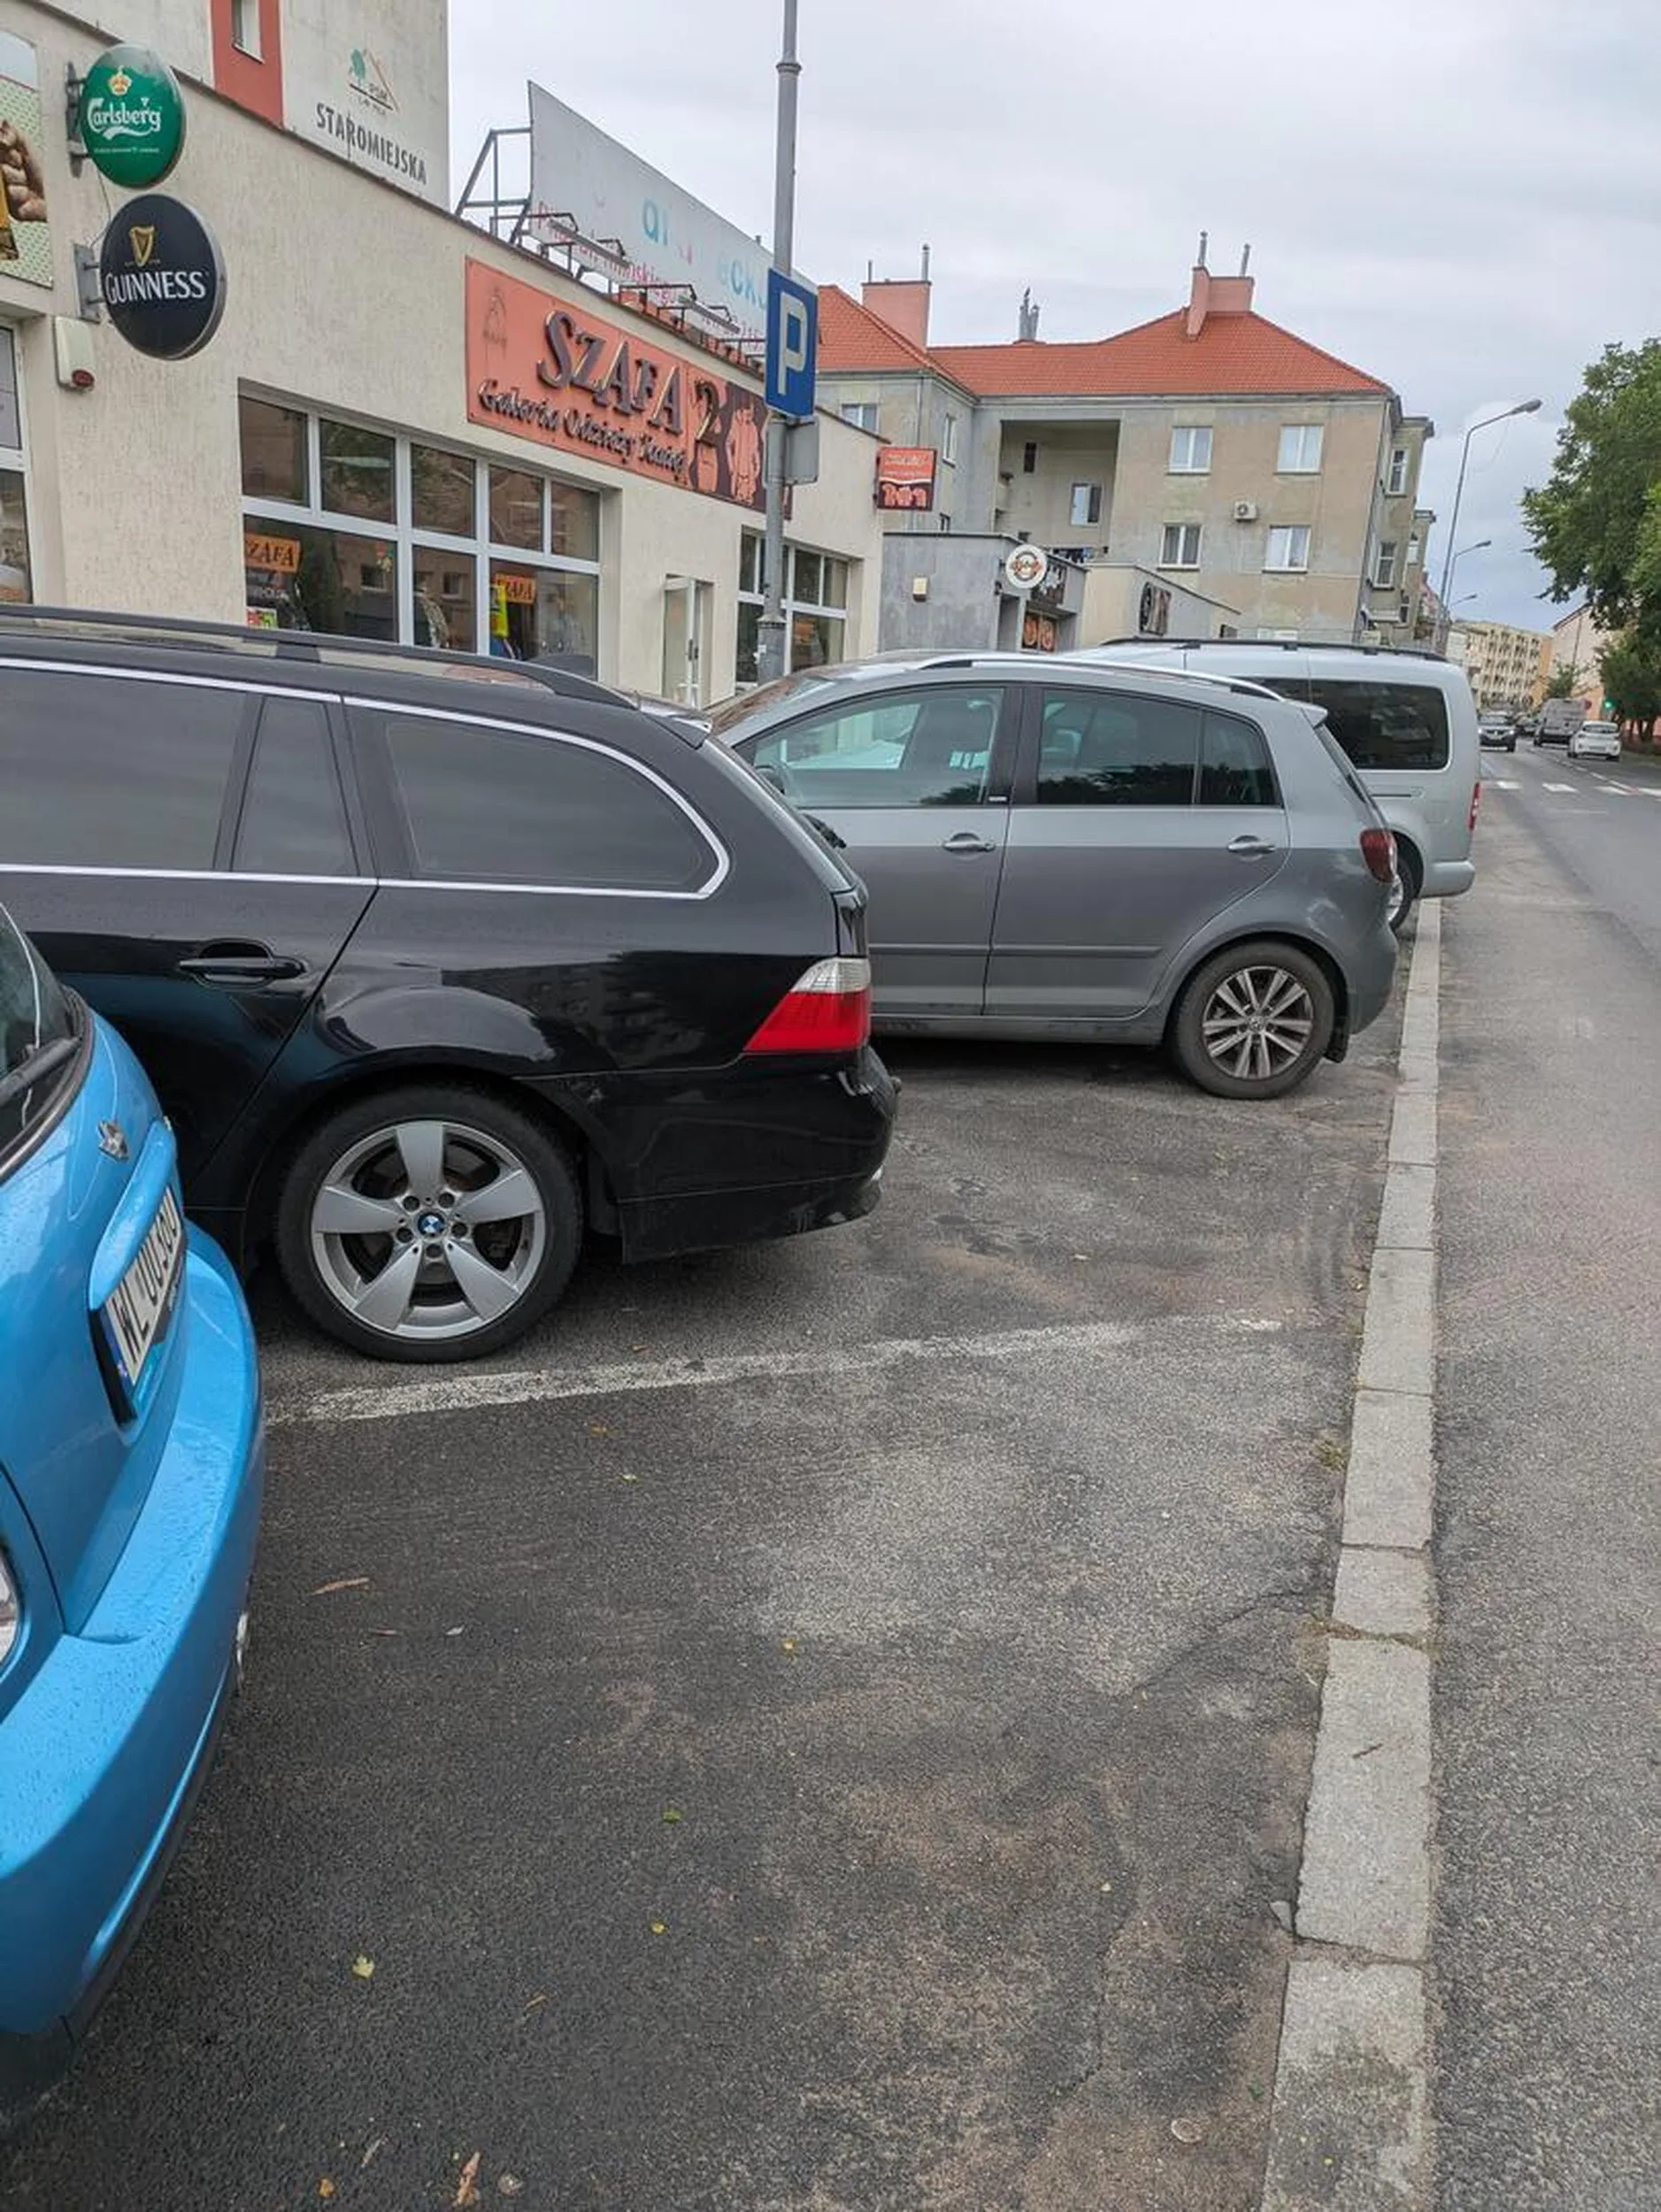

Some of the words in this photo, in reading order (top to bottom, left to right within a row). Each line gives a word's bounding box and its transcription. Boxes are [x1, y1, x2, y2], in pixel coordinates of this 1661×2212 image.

[87, 97, 161, 139] Carlsberg
[316, 103, 427, 185] STAROMIEJSKA
[105, 271, 206, 304] GUINNESS
[777, 289, 808, 396] P
[478, 378, 559, 432] Galeria
[536, 311, 682, 435] SZAFA
[694, 380, 721, 449] 2
